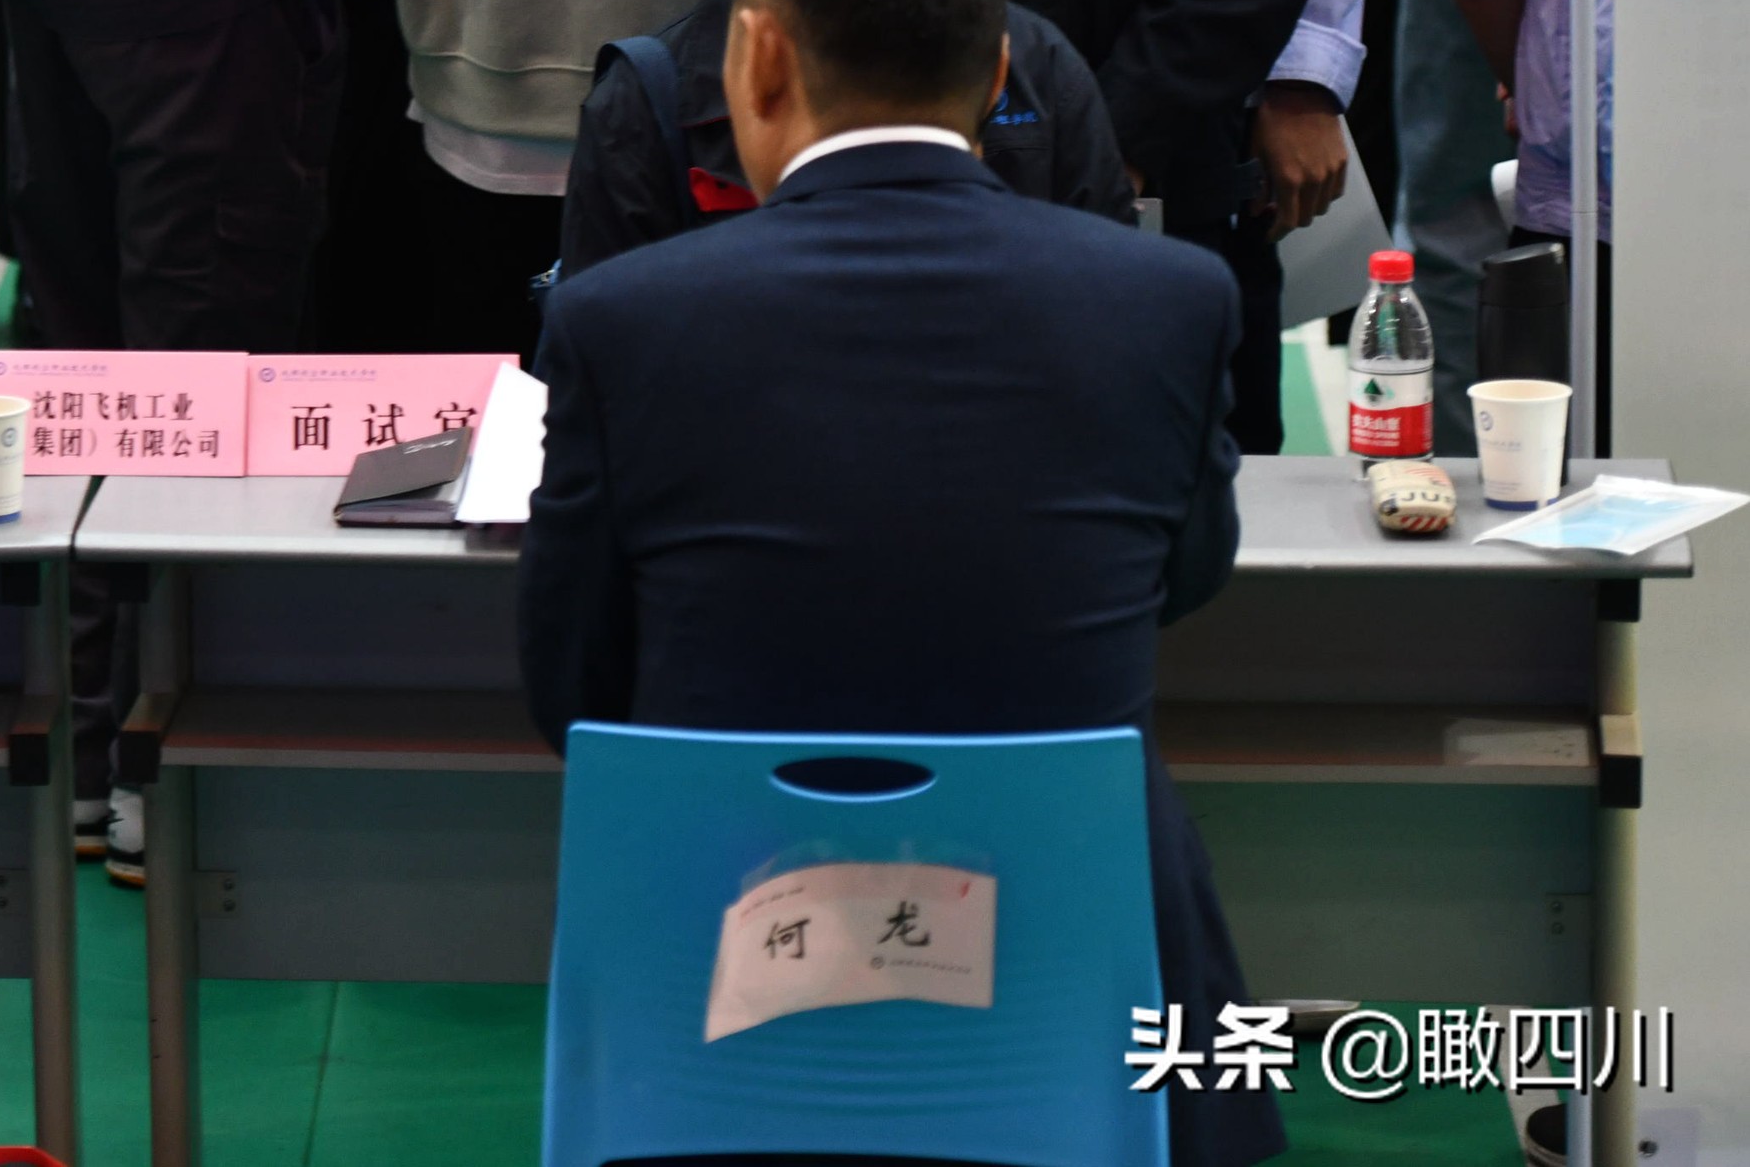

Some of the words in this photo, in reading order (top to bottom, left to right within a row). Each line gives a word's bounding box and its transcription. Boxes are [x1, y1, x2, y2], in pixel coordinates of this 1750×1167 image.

[33, 391, 194, 421] 沈阳飞机工业
[291, 401, 477, 451] 面试官
